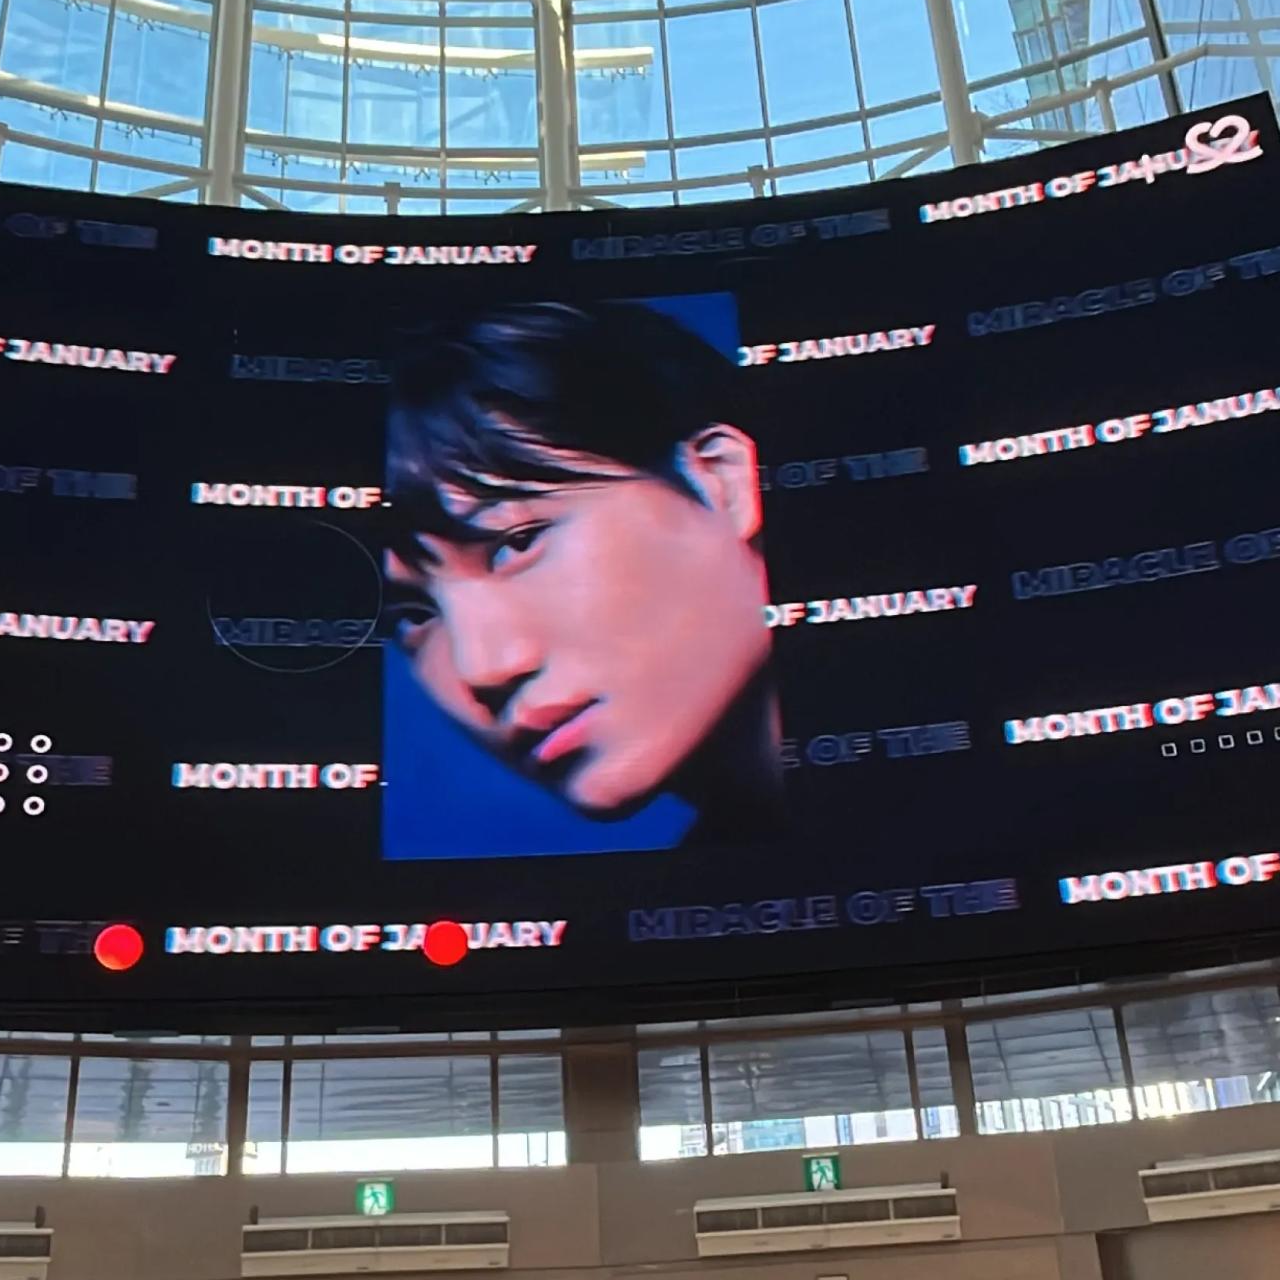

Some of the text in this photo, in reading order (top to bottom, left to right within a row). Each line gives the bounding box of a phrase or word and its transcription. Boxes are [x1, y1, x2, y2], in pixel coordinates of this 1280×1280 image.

[918, 180, 1045, 224] MONTH
[1044, 169, 1097, 200] OF
[208, 236, 538, 266] MONTH OF JANUARY
[749, 221, 807, 248] OF
[966, 276, 1158, 336] MIRACLE
[1160, 261, 1226, 297] OF
[5, 337, 178, 376] JANUARY
[777, 322, 937, 363] JANUARY
[230, 353, 393, 384] MIRACL
[958, 422, 1096, 467] MONTH
[1096, 412, 1152, 444] OF
[191, 481, 383, 509] MONTH OF
[1010, 540, 1221, 600] MIRACLE
[805, 583, 978, 625] JANUARY
[213, 618, 391, 647] MIRACL
[1003, 701, 1154, 746] MONTH
[1153, 692, 1216, 726] OF
[805, 731, 873, 766] OF
[172, 762, 380, 789] MONTH OF
[1057, 859, 1216, 904] MONTH
[628, 877, 1020, 942] MIRACLE OF THE
[165, 920, 568, 955] MONTH OF JAUARY
